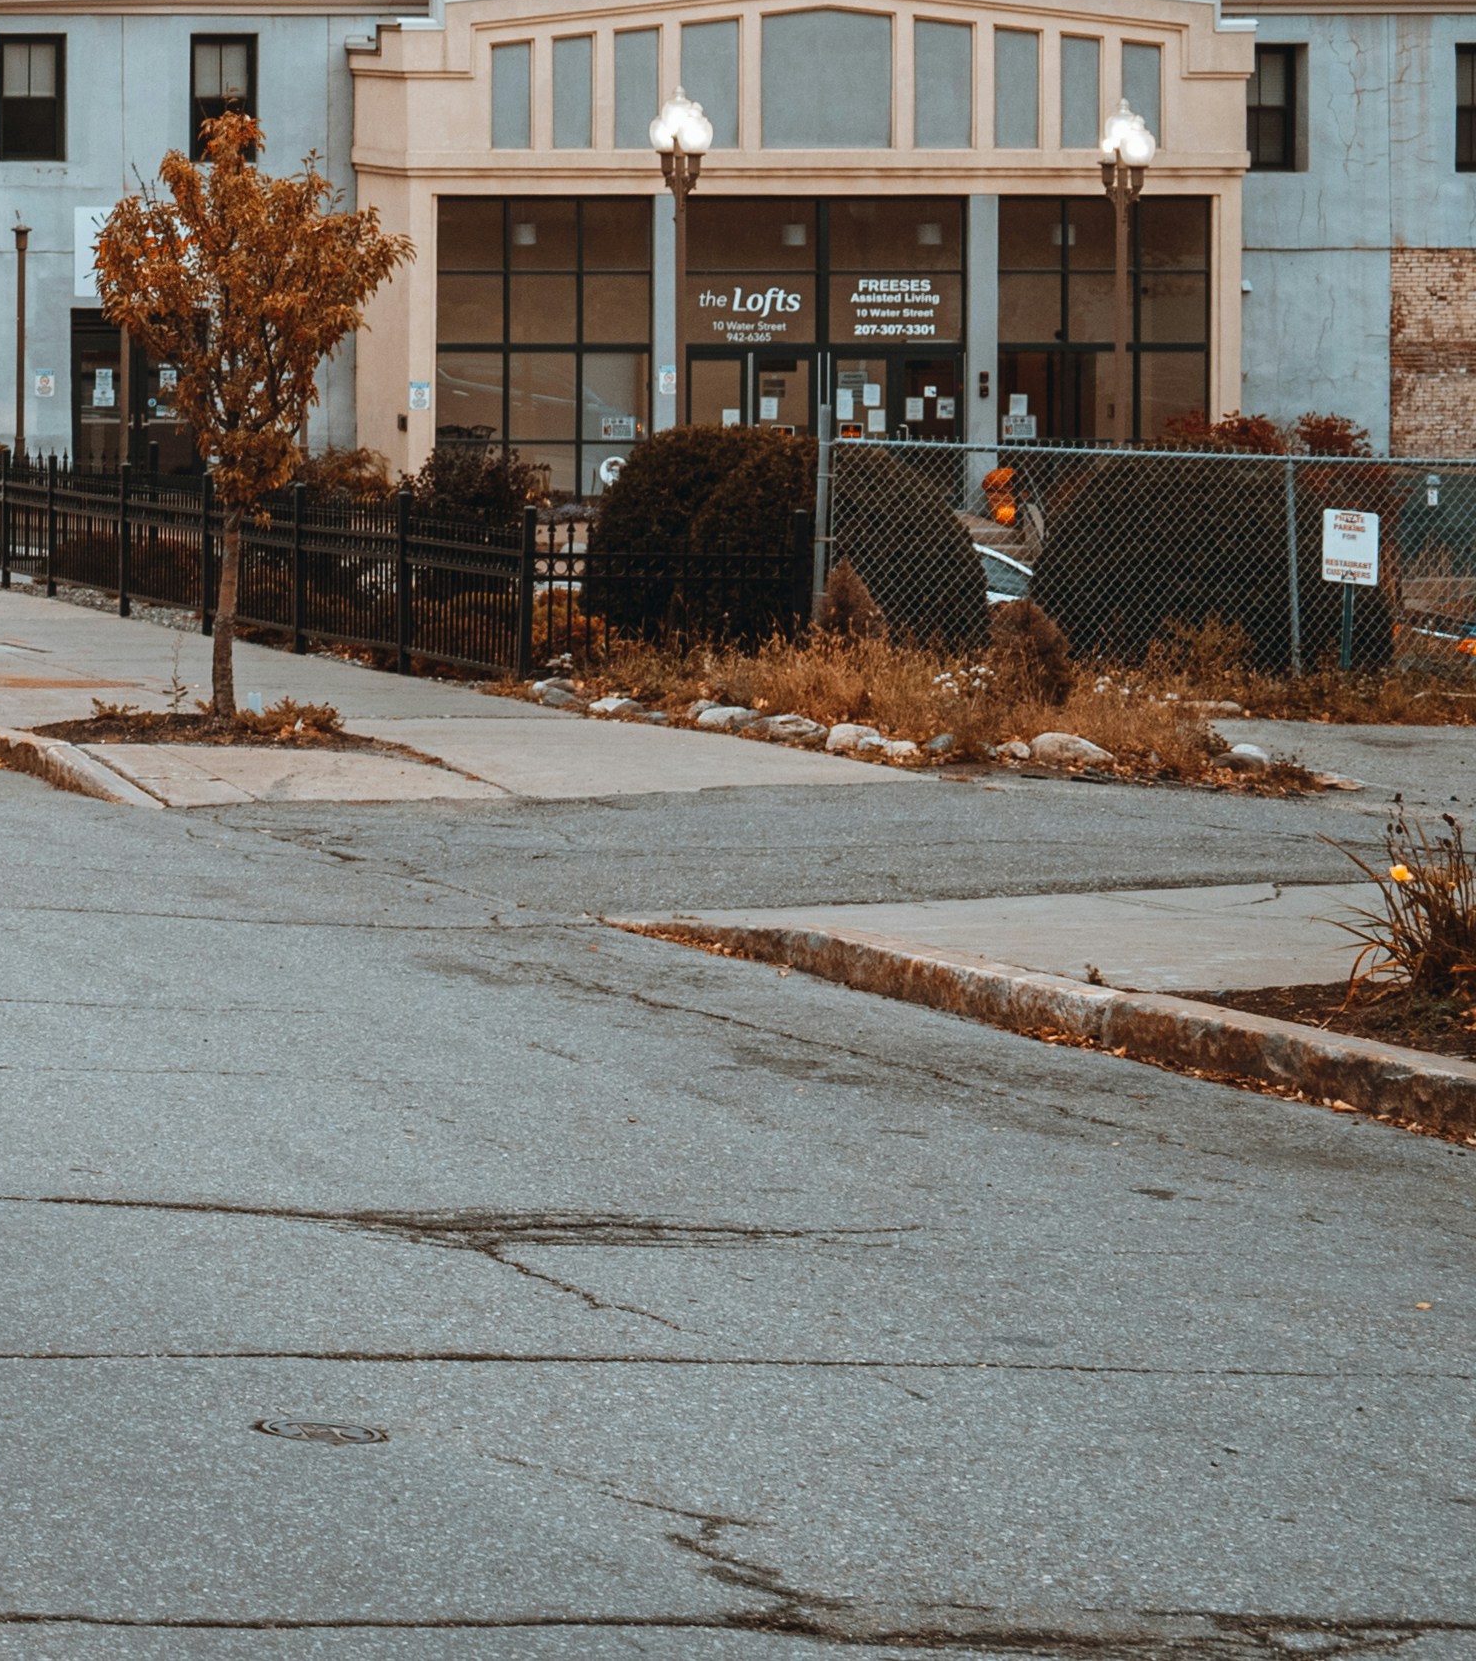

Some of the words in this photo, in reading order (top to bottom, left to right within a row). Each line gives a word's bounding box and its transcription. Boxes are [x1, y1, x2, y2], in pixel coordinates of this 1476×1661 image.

[858, 279, 931, 292] FREESES
[699, 290, 727, 307] the
[732, 287, 801, 317] Lofts
[851, 292, 901, 303] Assisted
[905, 293, 940, 305] Living
[856, 309, 868, 317] 10
[870, 308, 900, 318] Water
[903, 308, 934, 317] Street
[713, 321, 724, 331] 10
[726, 321, 755, 331] Water
[758, 321, 787, 331] Street
[854, 324, 935, 335] 207-307-3301
[726, 332, 772, 342] 942-6365
[1333, 523, 1366, 532] PARKING
[1325, 558, 1372, 570] RESTAURANT
[1326, 567, 1371, 579] CUSTERS
